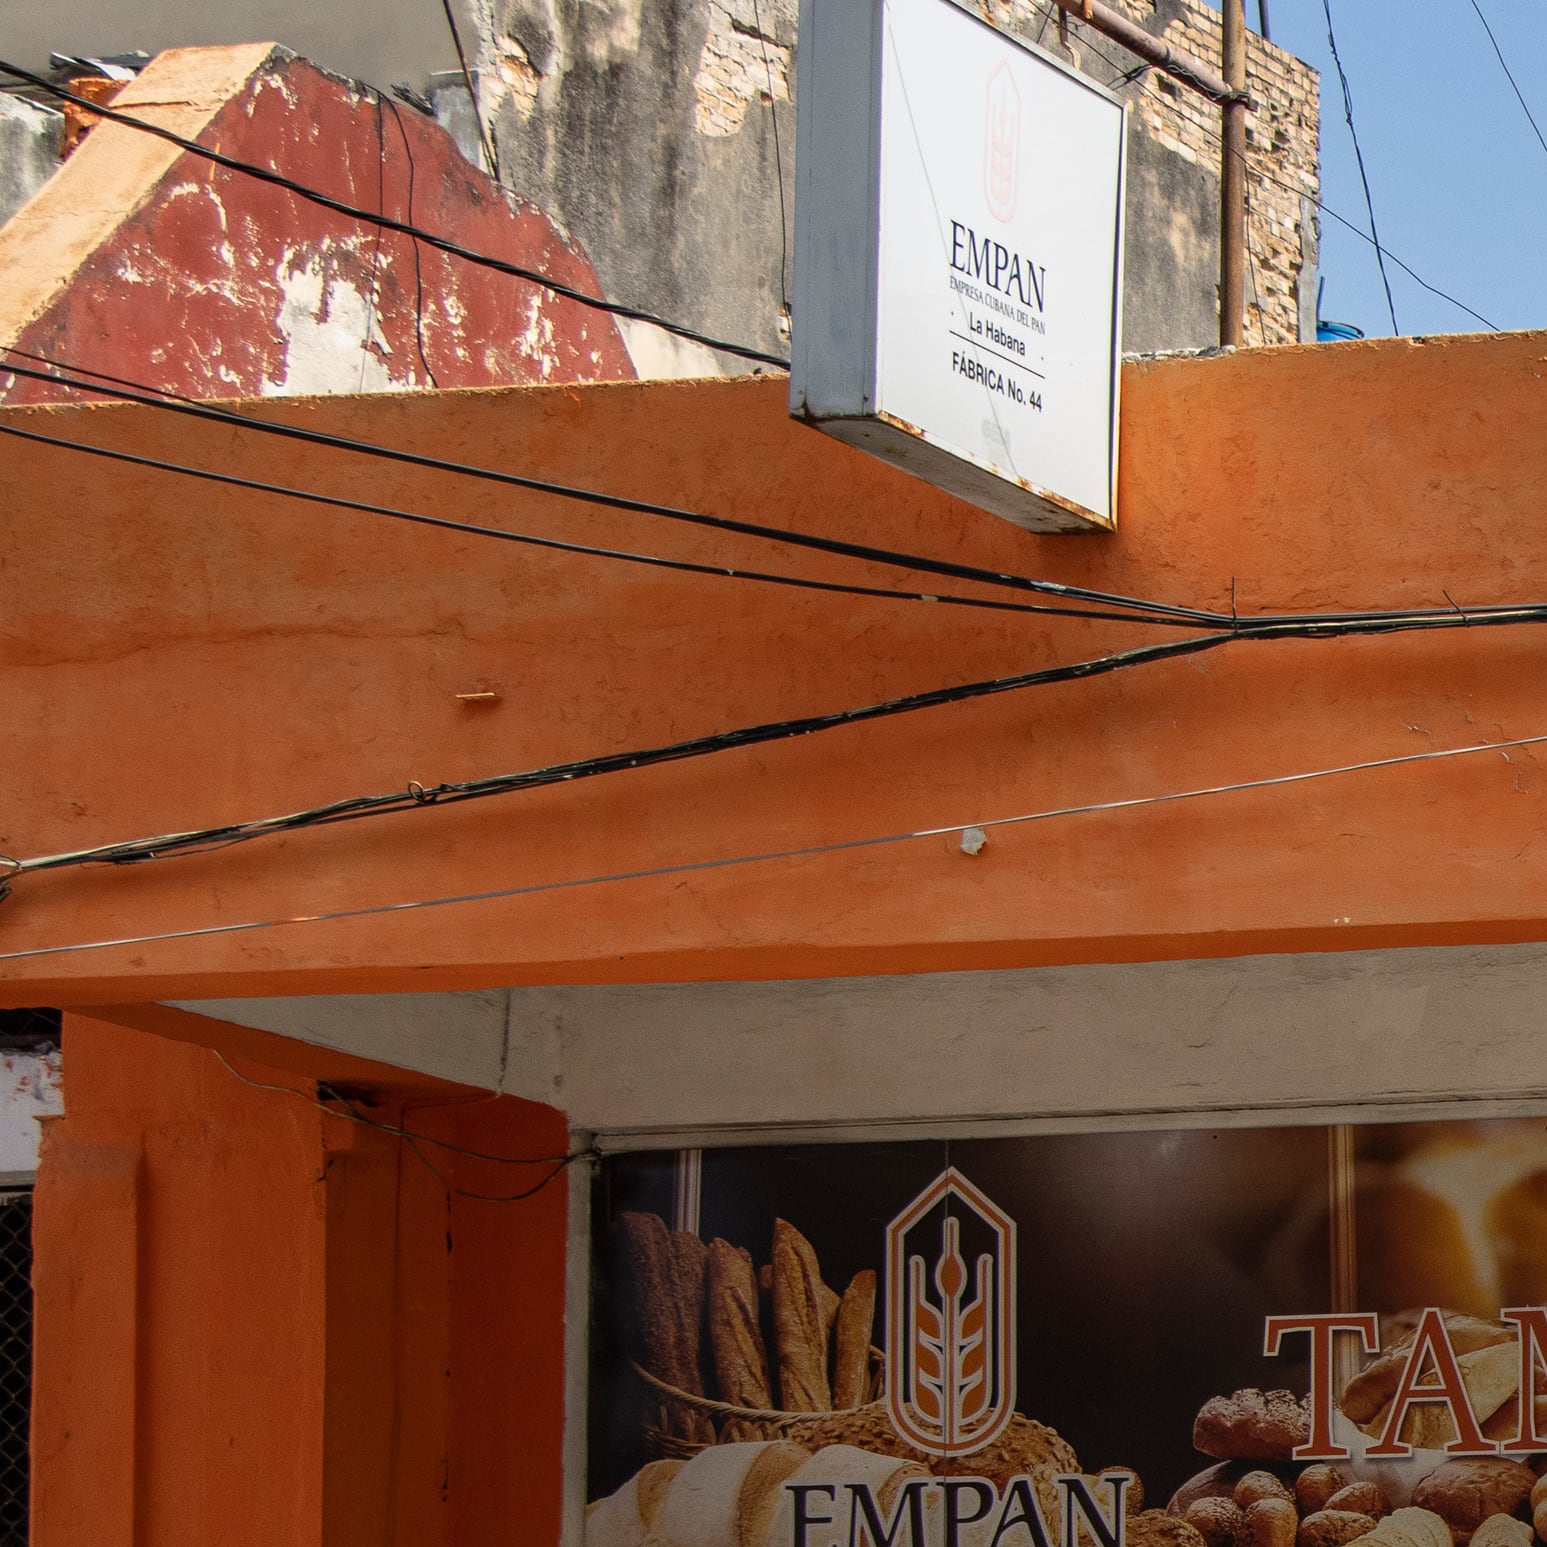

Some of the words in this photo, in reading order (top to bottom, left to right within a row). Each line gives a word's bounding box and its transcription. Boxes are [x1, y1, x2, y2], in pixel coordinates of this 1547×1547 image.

[950, 219, 1046, 313] EMPAN
[949, 275, 984, 305] EMPRESA
[985, 292, 1015, 321] CUBANA
[1016, 308, 1030, 328] DEL
[1031, 317, 1046, 336] PAN
[970, 311, 983, 335] La
[986, 319, 1026, 356] Habana
[952, 351, 1005, 395] FÁBRICA
[1008, 378, 1026, 405] No.
[1029, 390, 1042, 413] 44
